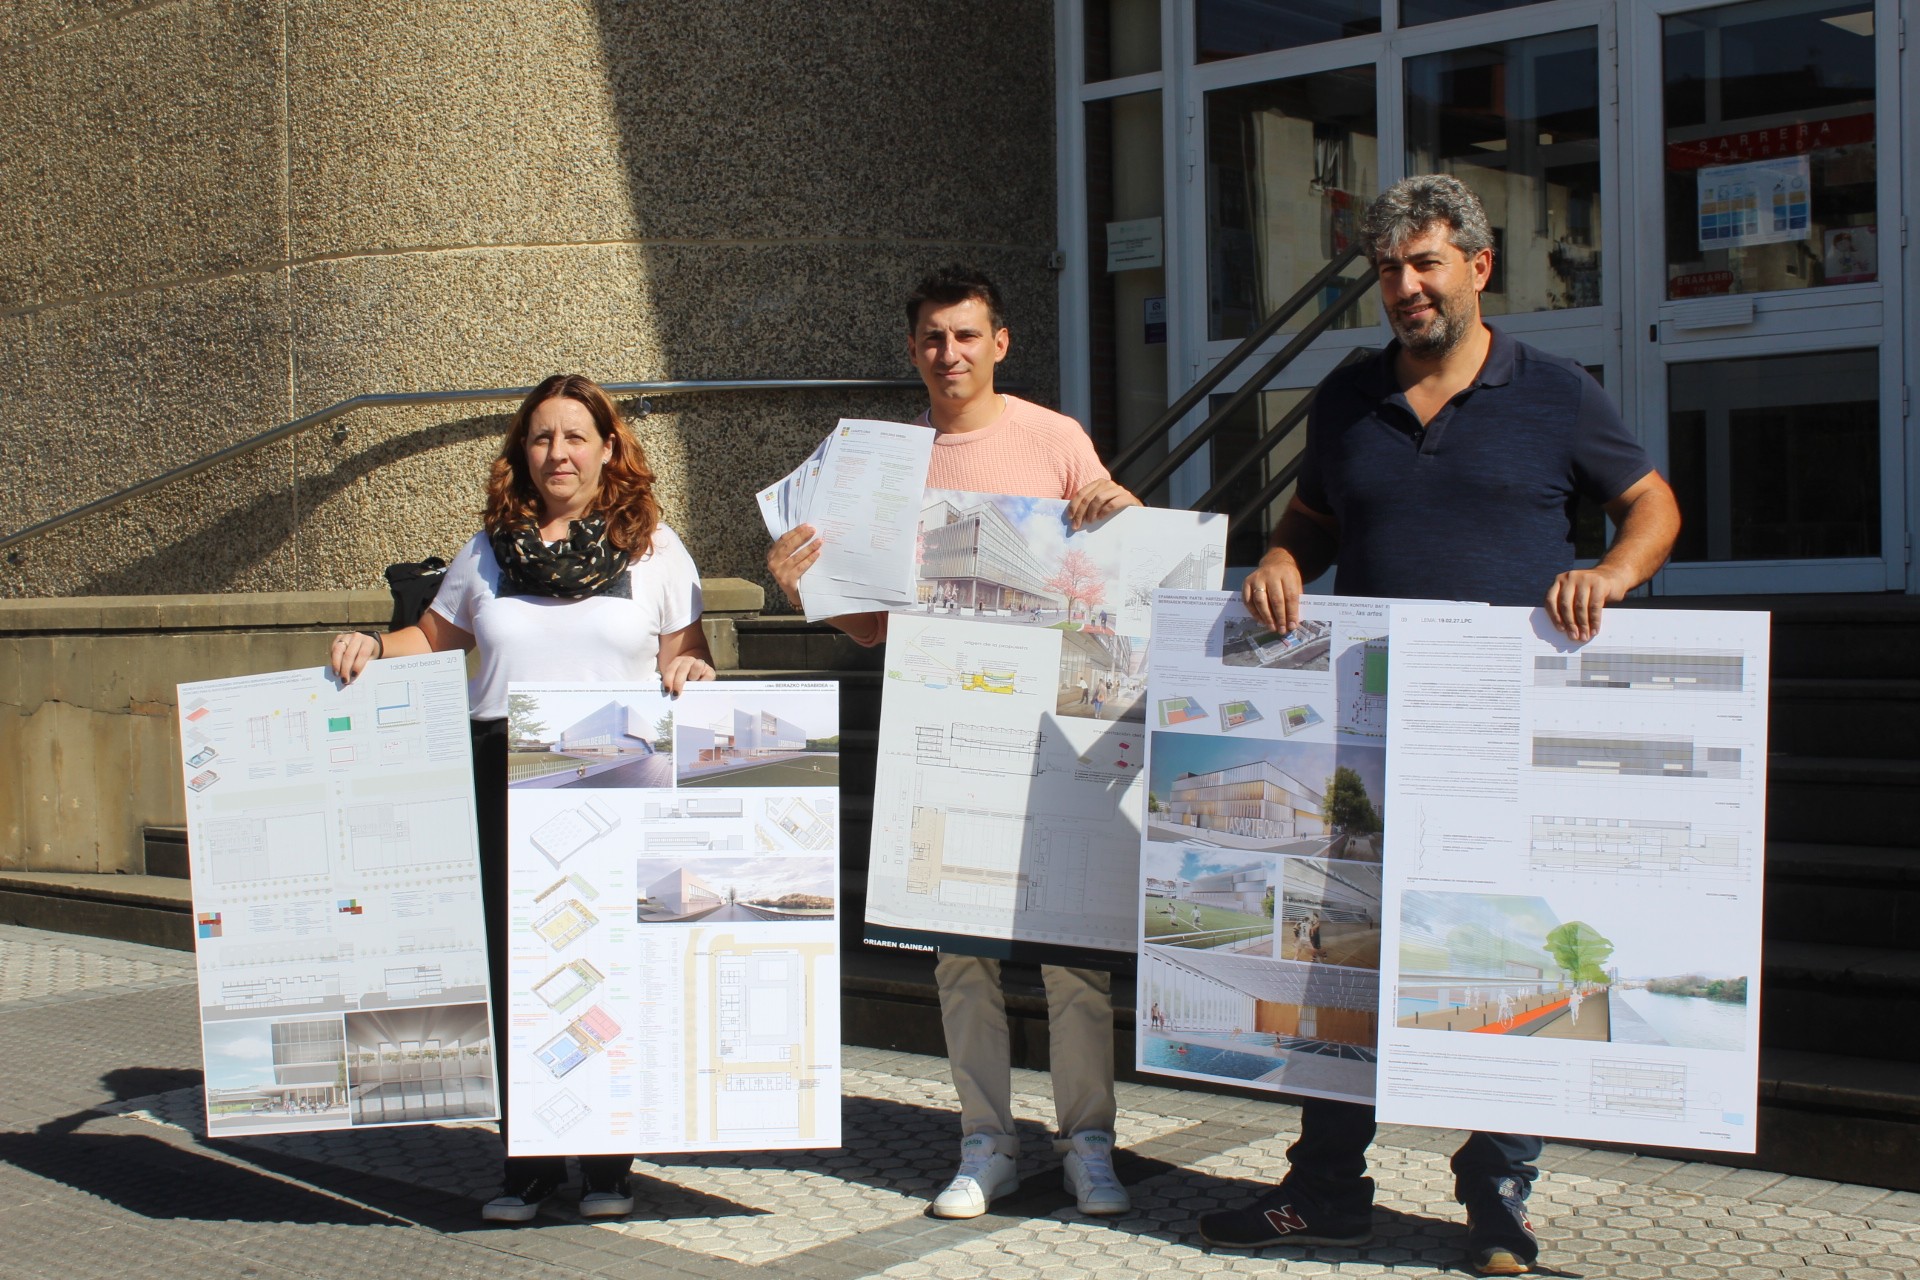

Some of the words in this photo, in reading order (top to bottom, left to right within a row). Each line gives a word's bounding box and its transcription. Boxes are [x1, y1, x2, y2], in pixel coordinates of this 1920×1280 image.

[1699, 122, 1830, 152] SARRERA
[1714, 138, 1821, 161] ENTRADA
[1677, 273, 1732, 286] ERAKARRI
[420, 659, 440, 667] bezala
[863, 938, 898, 948] ORIAREN
[899, 942, 934, 952] GAINEAN
[1084, 1135, 1108, 1145] adidas
